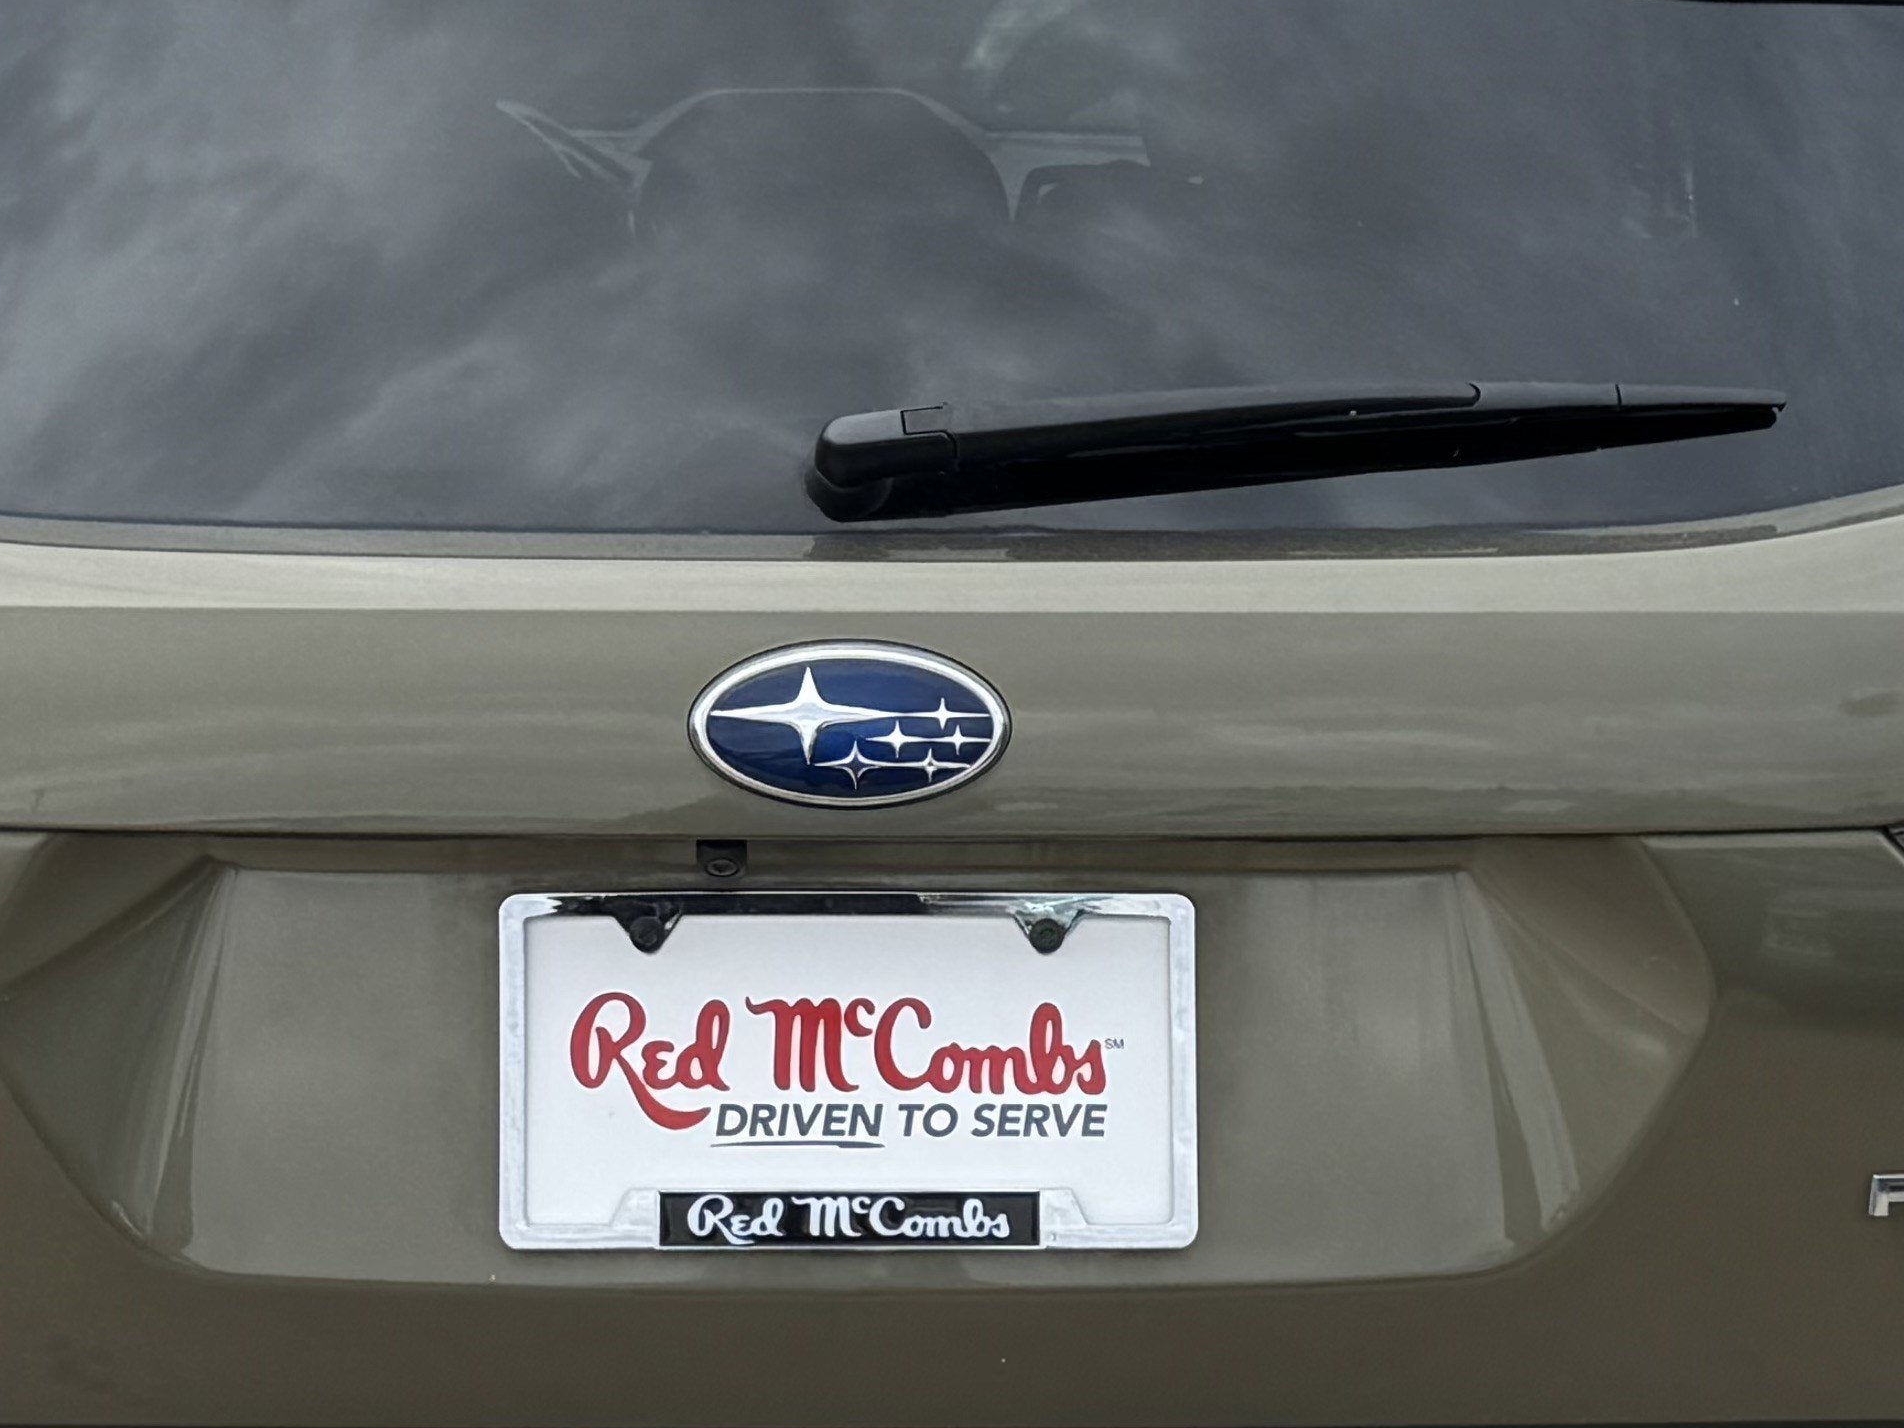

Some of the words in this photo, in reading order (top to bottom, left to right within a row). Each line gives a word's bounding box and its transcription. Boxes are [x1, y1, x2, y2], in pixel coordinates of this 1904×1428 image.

[570, 990, 731, 1132] Red
[744, 995, 1108, 1096] McCombs
[714, 1102, 886, 1140] DRIVEN
[897, 1102, 959, 1140] TO
[970, 1102, 1109, 1140] SERVE
[686, 1192, 787, 1244] Red
[791, 1193, 1011, 1240] McCombs
